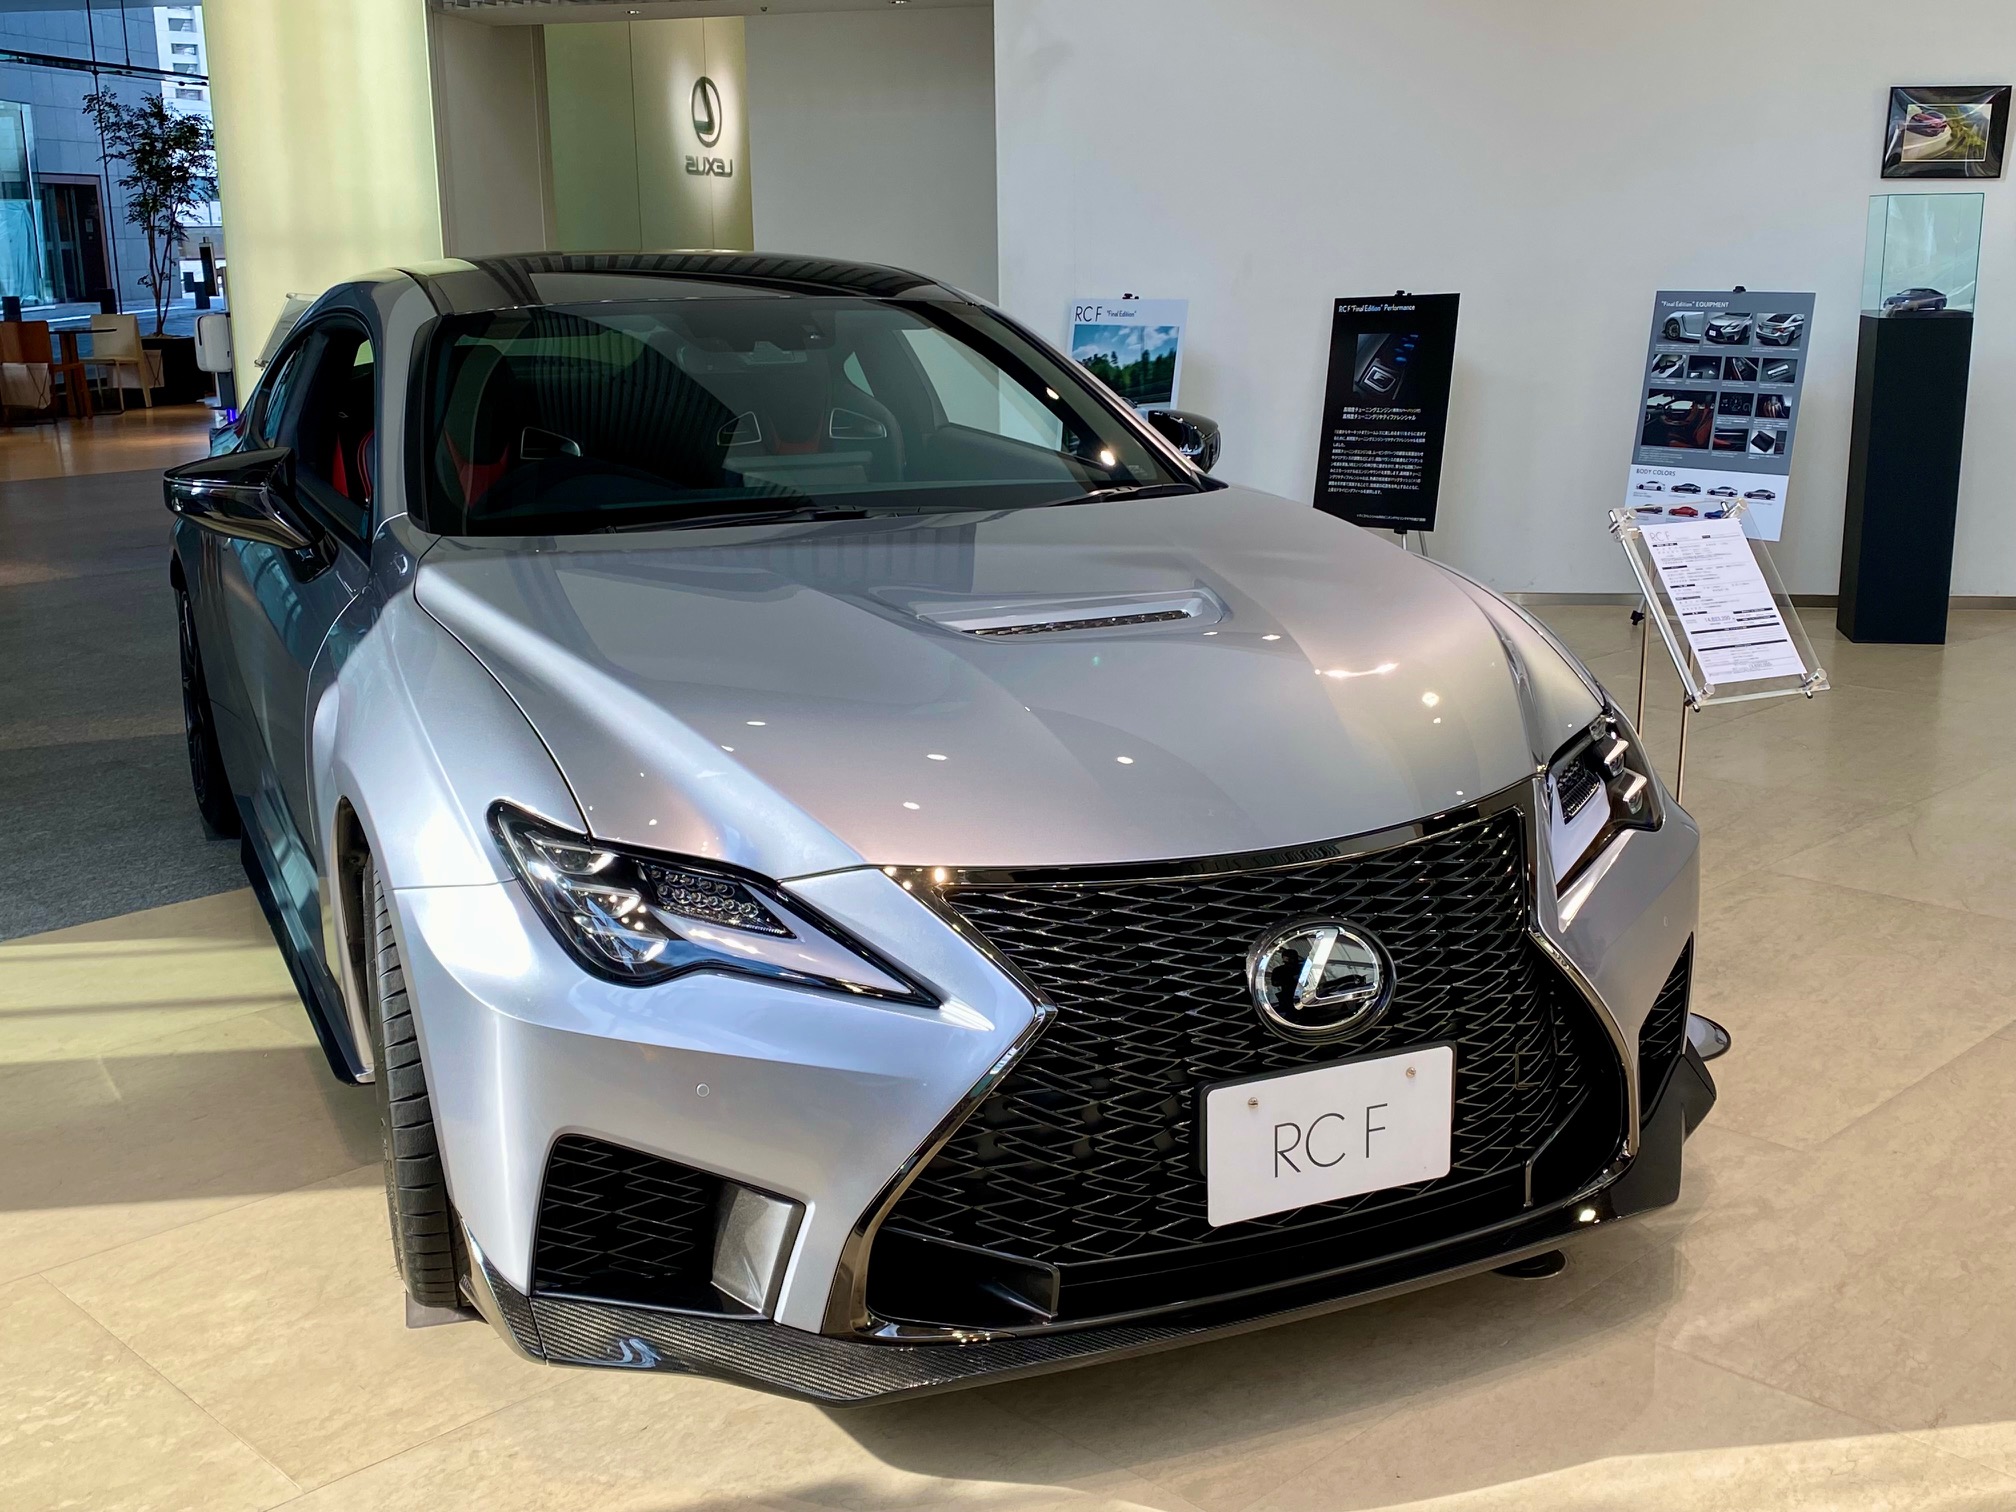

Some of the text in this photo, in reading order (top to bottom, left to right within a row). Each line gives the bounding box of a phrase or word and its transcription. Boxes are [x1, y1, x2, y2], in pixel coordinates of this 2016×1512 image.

[1075, 306, 1093, 322] RC
[1095, 306, 1103, 322] F
[1383, 304, 1415, 312] Performance
[1650, 531, 1671, 541] RC F
[1274, 1103, 1388, 1178] RC F
